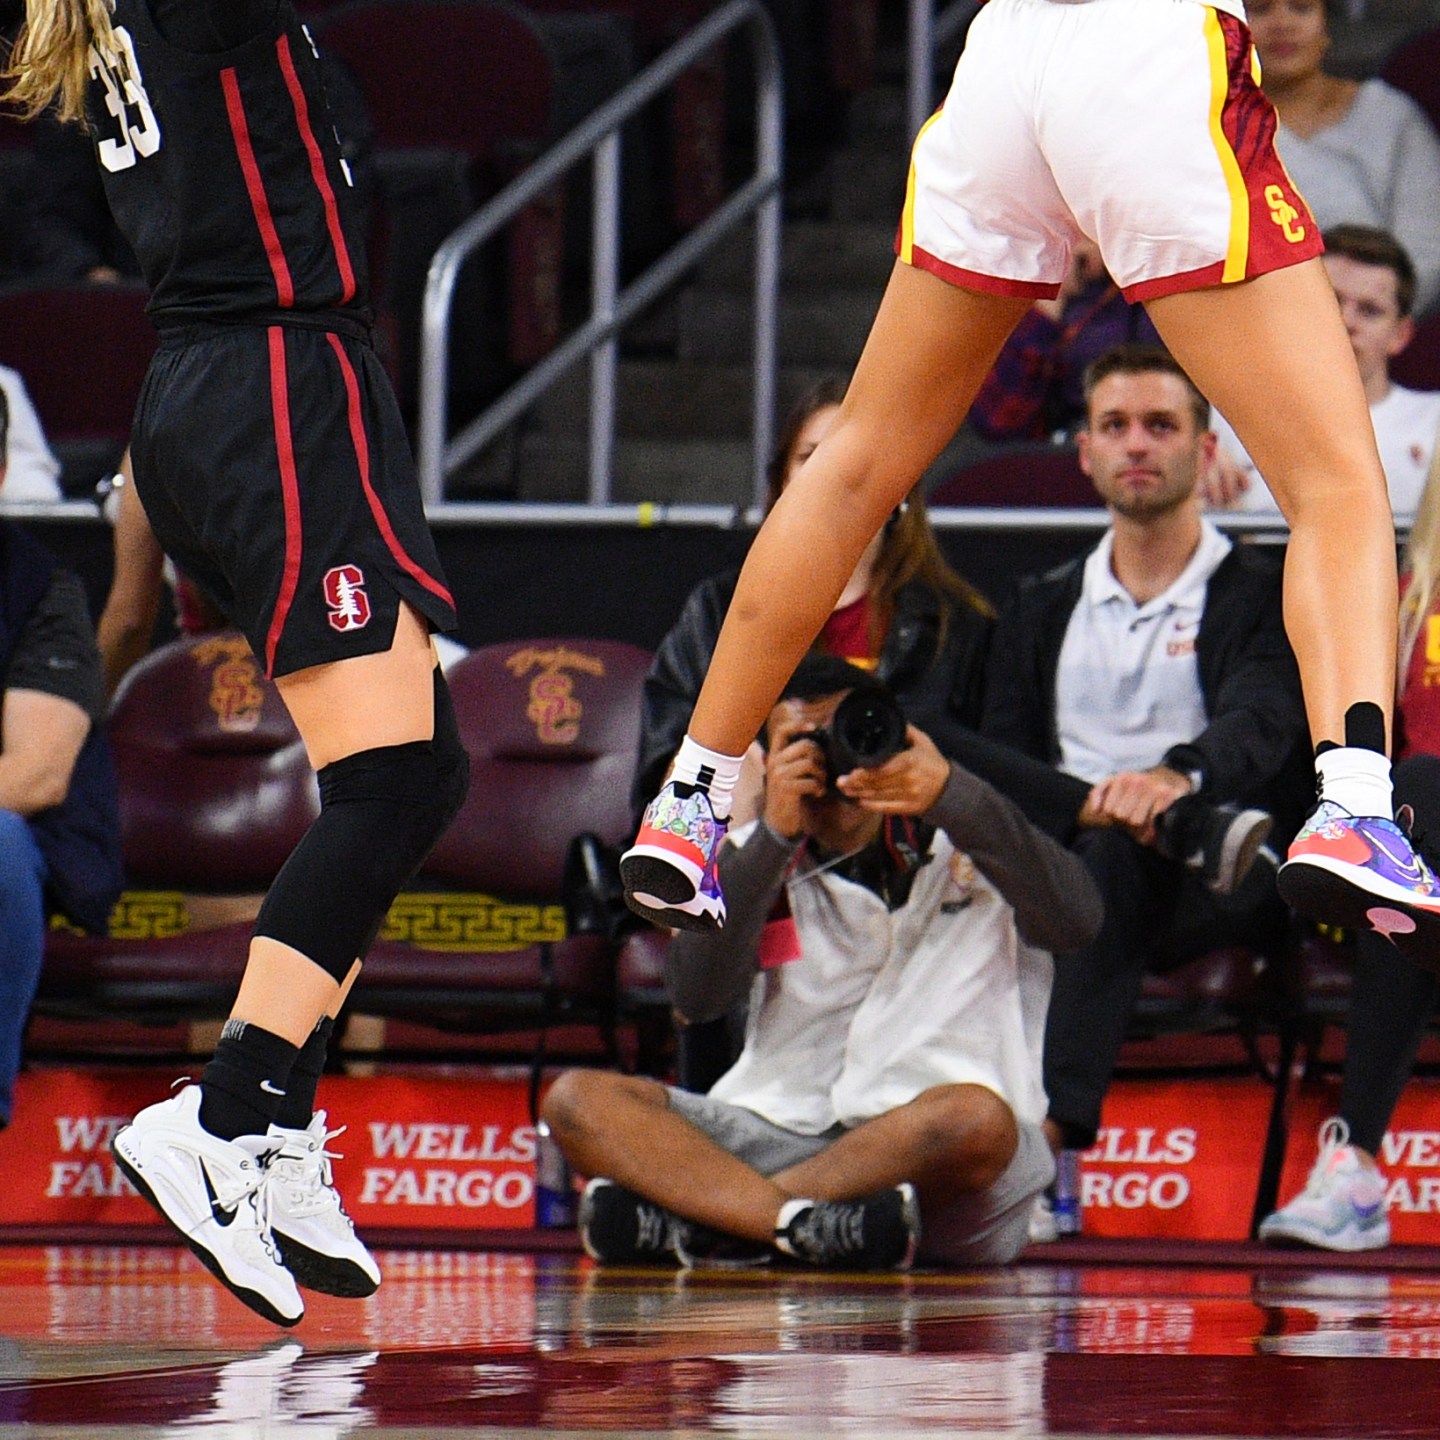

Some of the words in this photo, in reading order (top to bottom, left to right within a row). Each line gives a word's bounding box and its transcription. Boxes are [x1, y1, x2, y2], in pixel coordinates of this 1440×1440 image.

[89, 25, 161, 173] 33
[369, 1122, 538, 1162] WELLS
[359, 1167, 534, 1209] FARGO
[1081, 1171, 1190, 1209] RGO
